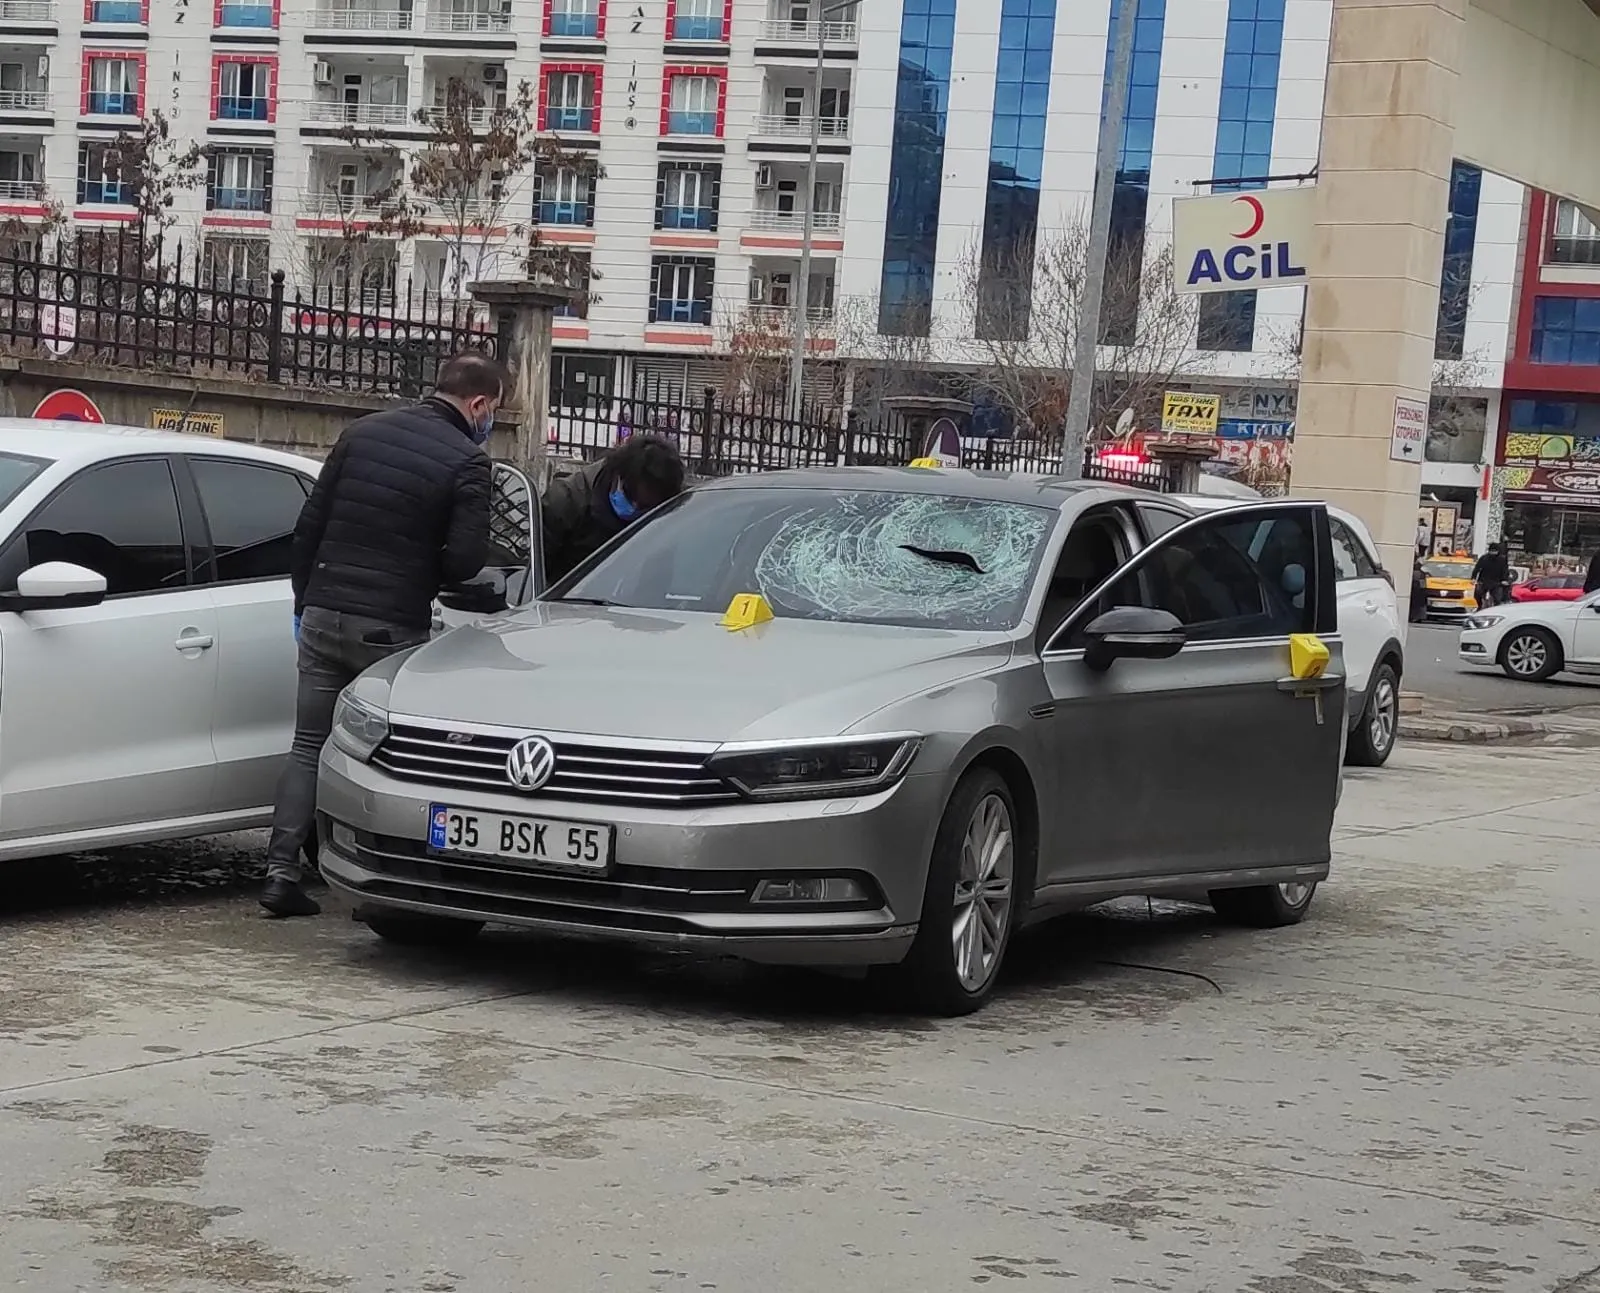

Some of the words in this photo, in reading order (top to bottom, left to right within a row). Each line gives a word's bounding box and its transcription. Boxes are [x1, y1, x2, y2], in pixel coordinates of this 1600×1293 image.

[628, 59, 637, 111] İNŞ
[1166, 403, 1215, 419] TAXI
[742, 599, 750, 616] 1
[434, 829, 445, 841] TR
[449, 814, 479, 848] 35
[501, 820, 548, 856] BSK
[566, 827, 600, 862] 55
